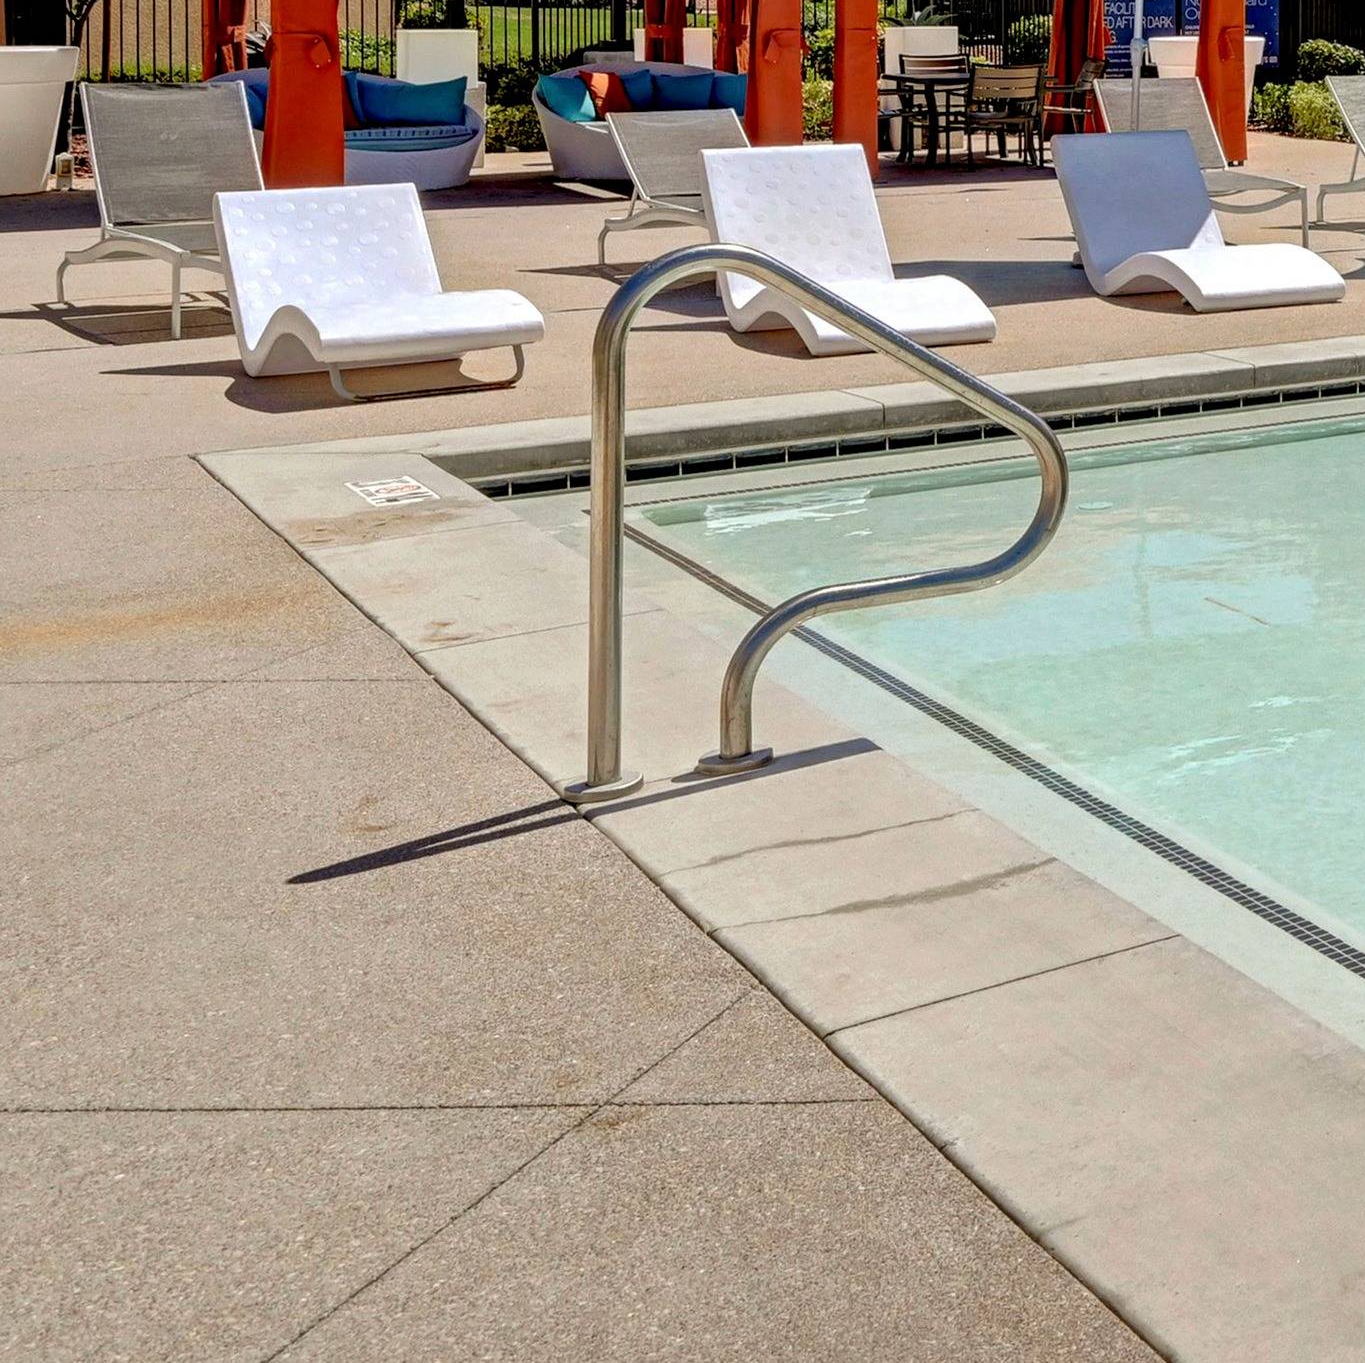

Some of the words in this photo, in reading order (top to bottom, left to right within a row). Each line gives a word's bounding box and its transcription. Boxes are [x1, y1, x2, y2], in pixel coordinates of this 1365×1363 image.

[1104, 2, 1137, 15] FACILIT
[1115, 16, 1147, 29] AFTR
[1147, 16, 1174, 29] DARK
